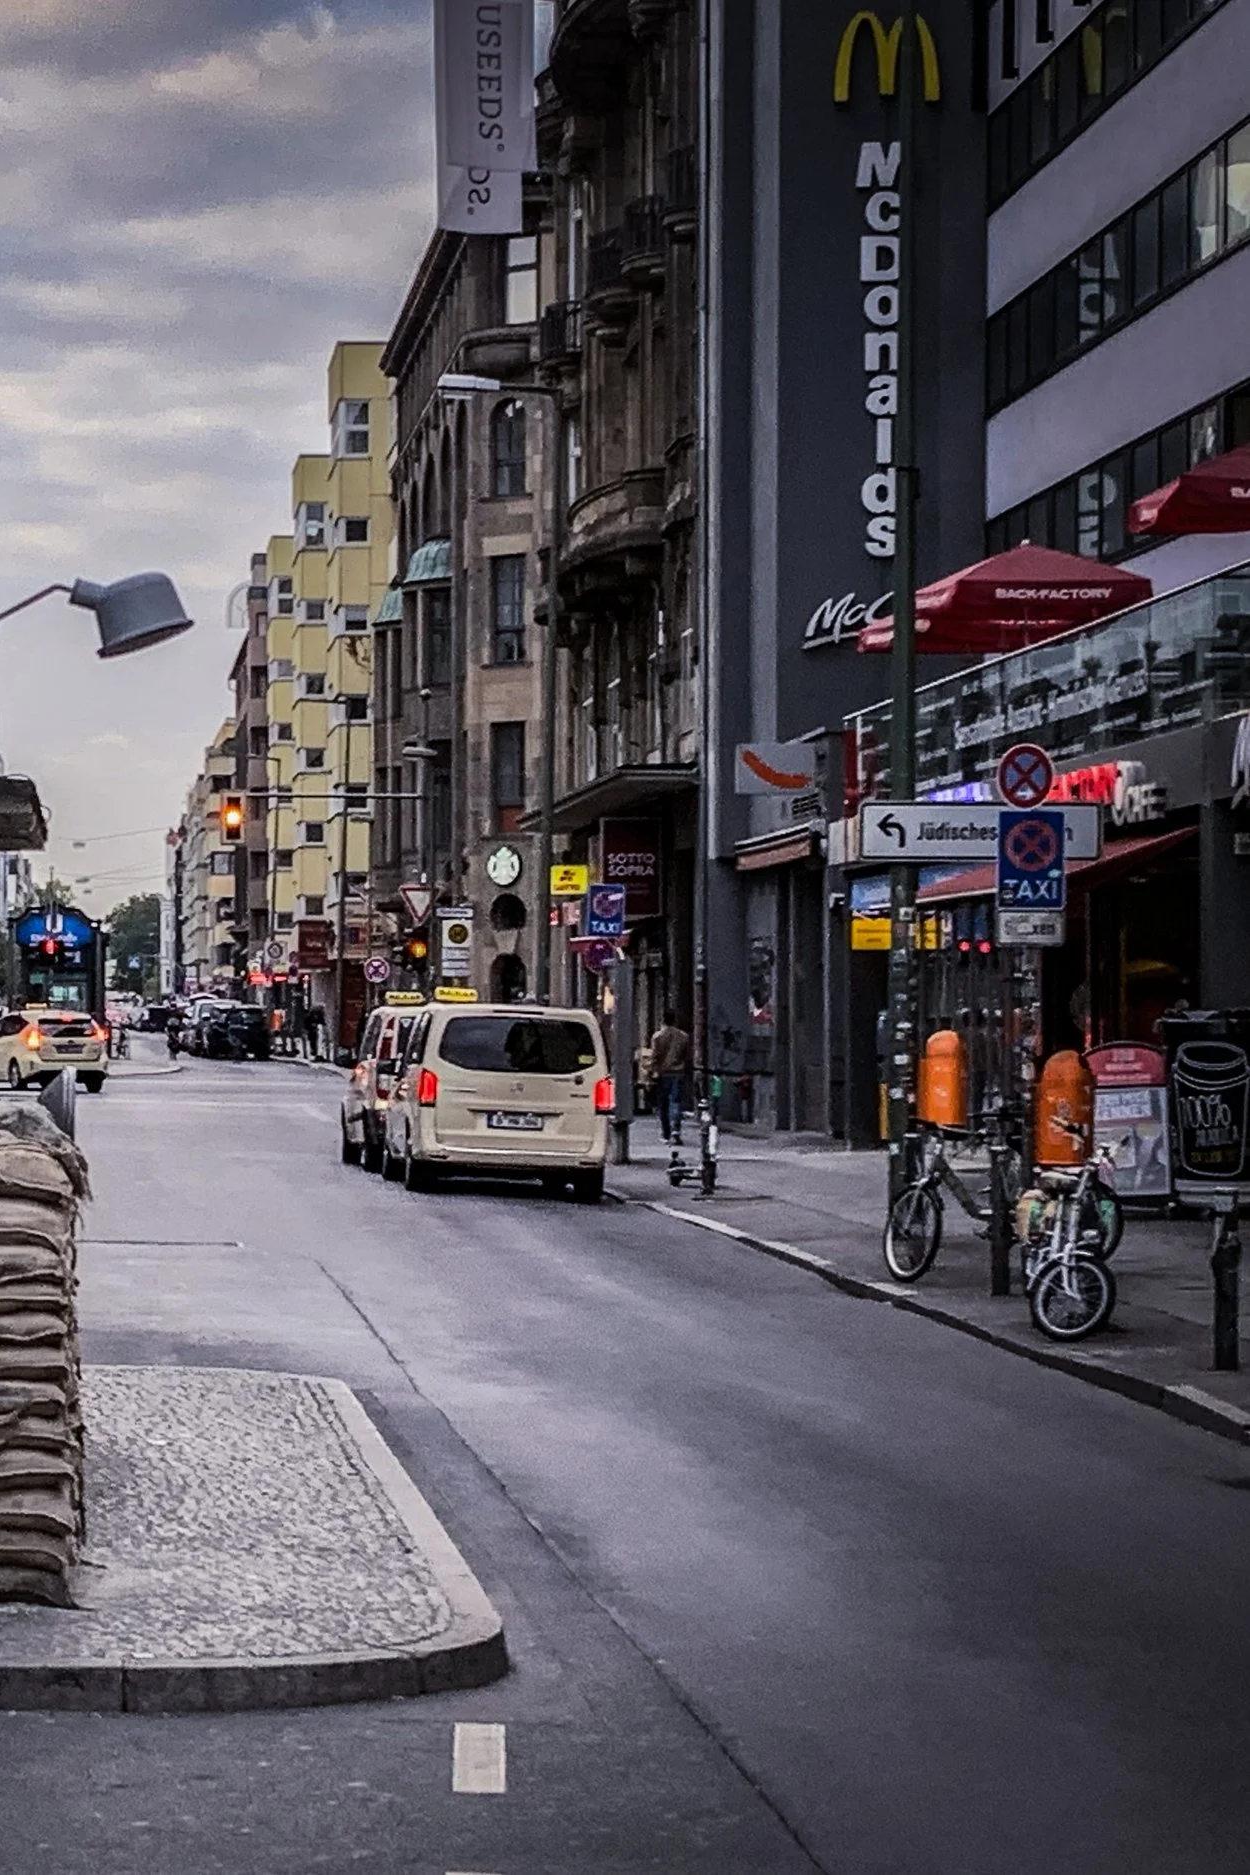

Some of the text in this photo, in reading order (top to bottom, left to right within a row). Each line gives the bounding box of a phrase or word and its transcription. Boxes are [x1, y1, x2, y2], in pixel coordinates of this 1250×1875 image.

[917, 820, 998, 841] Jüdisches
[607, 852, 656, 865] SOTTO
[607, 864, 655, 877] SOPRA
[1003, 879, 1058, 900] TAXI
[591, 920, 622, 934] TAXI
